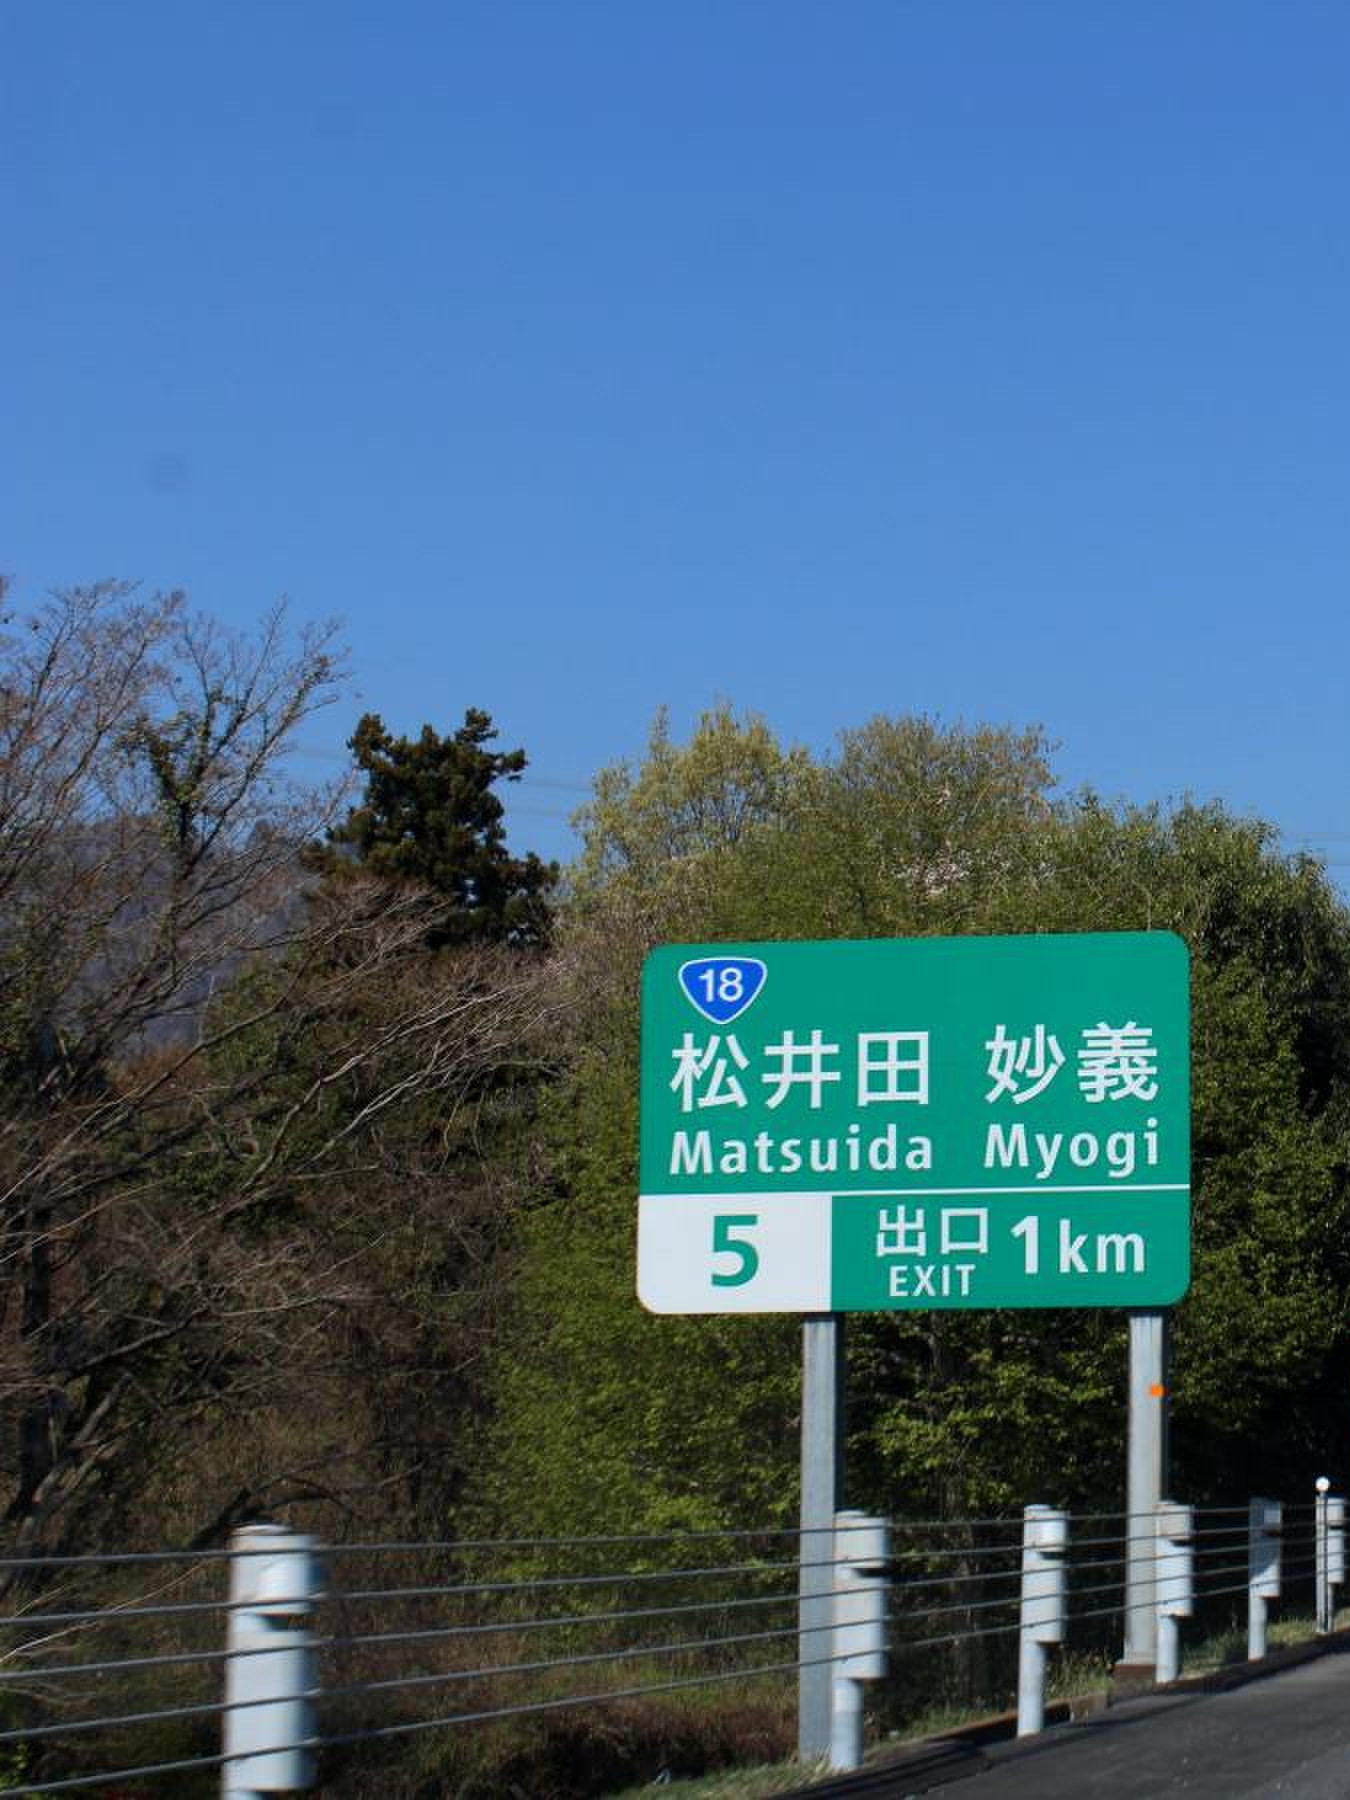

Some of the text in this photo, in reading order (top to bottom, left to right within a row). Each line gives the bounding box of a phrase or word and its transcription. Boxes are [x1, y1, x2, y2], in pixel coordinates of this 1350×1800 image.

[699, 967, 744, 1003] 18
[669, 1021, 1159, 1112] 松井田 妙義
[669, 1117, 1160, 1179] Matsuida Myogi
[710, 1213, 760, 1288] 5
[876, 1203, 990, 1258] 出口
[888, 1263, 977, 1298] EXIT
